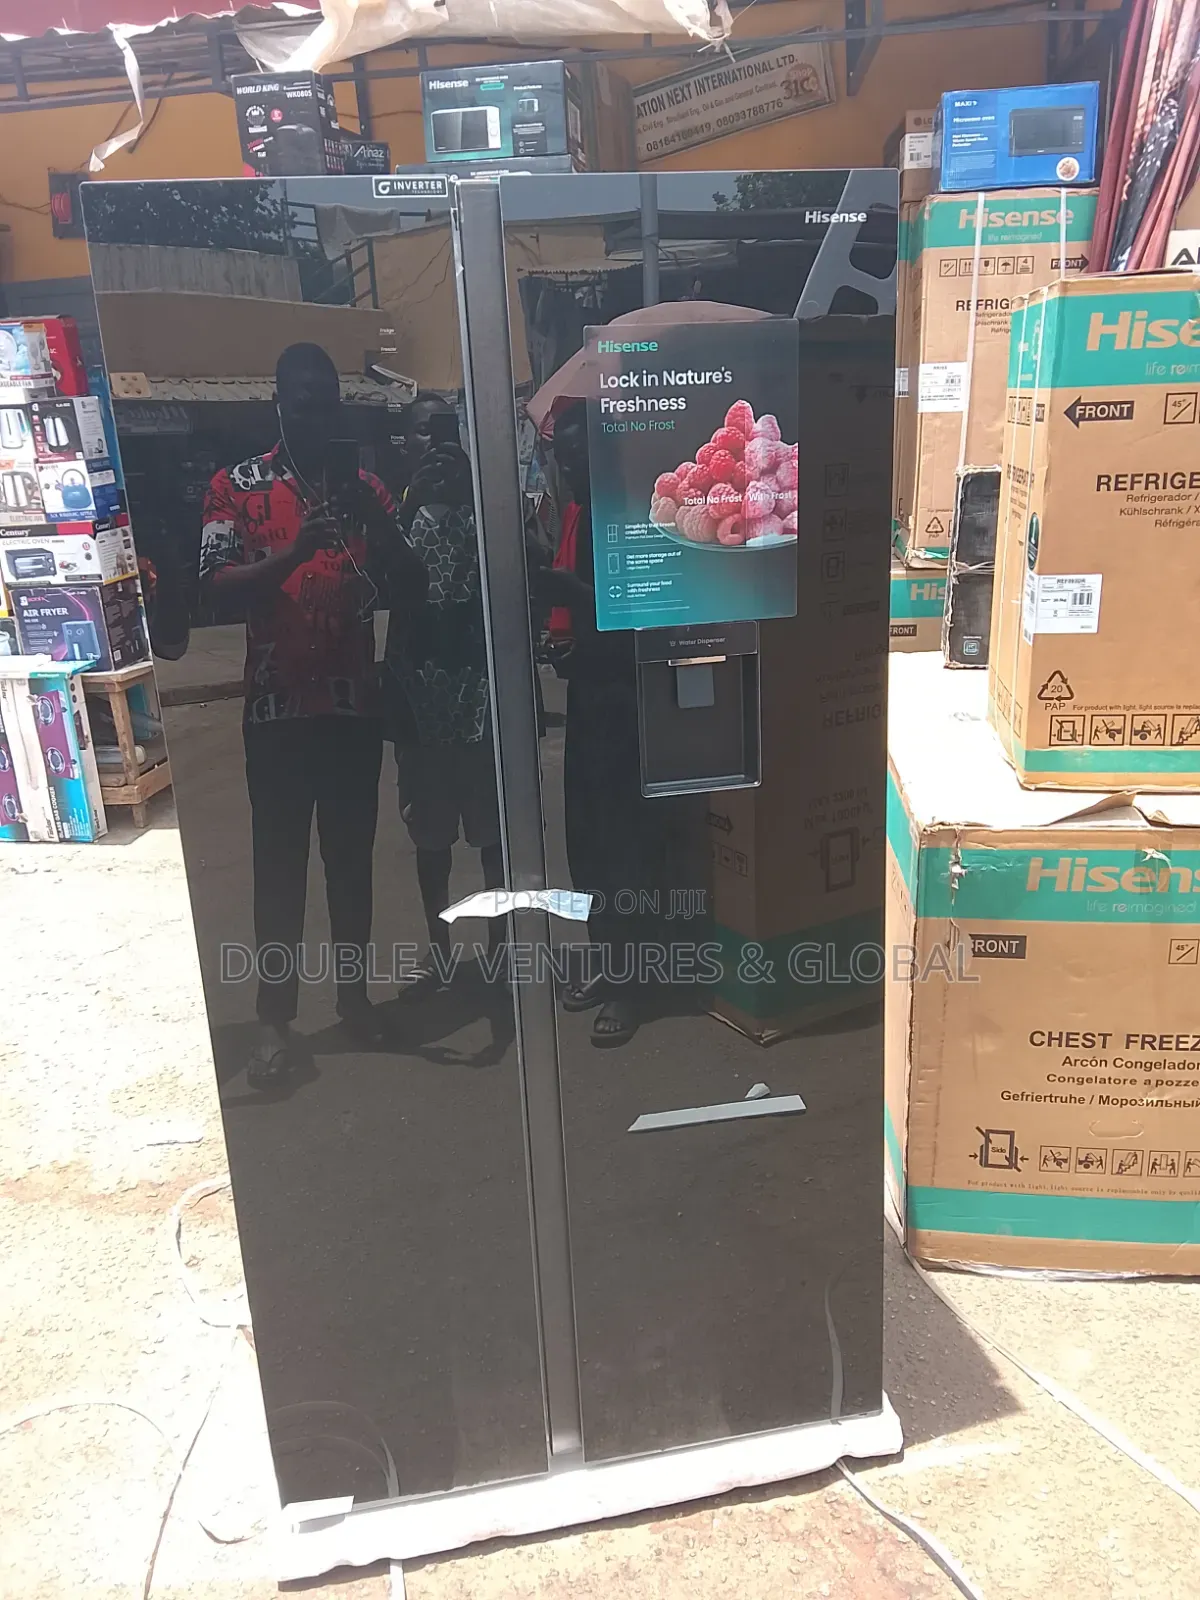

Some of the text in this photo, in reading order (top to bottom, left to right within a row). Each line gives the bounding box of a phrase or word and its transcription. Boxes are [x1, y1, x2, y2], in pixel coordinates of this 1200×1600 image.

[236, 85, 261, 94] WORLD
[262, 84, 280, 92] KING
[429, 79, 469, 90] Hisense
[636, 54, 798, 119] ATION NEXT INTERNATIONAL LTD.
[393, 181, 443, 190] INVERTER
[804, 210, 867, 224] Hisense
[958, 208, 1075, 229] Hisense
[956, 298, 1013, 312] REFRIG
[598, 340, 658, 353] Hisense
[1145, 362, 1166, 375] life
[600, 366, 733, 389] Lock in Nature's
[600, 396, 687, 414] Freshness
[1075, 404, 1131, 419] FRONT
[602, 419, 676, 433] Total No Frost
[1096, 472, 1200, 492] REFRIGE
[683, 494, 742, 506] Total No Frost
[771, 491, 793, 500] Frost
[1126, 493, 1193, 504] Refrigerador
[1119, 505, 1184, 517] Kühlschrank
[0, 529, 29, 537] Century
[23, 607, 69, 617] AIR FRYER
[890, 626, 914, 634] FRONT
[697, 637, 726, 646] Dispenser
[1051, 685, 1063, 693] 20
[1045, 702, 1066, 711] PAP
[49, 786, 58, 809] COOKER
[1026, 857, 1200, 893] Hisen
[1086, 899, 1197, 917] life reimagined
[1029, 1030, 1200, 1052] CHEST FREEZ
[1061, 1056, 1109, 1069] Arcón
[1046, 1073, 1138, 1086] Congelatore
[1143, 1078, 1152, 1086] a
[1001, 1091, 1086, 1105] Gefriertruhe
